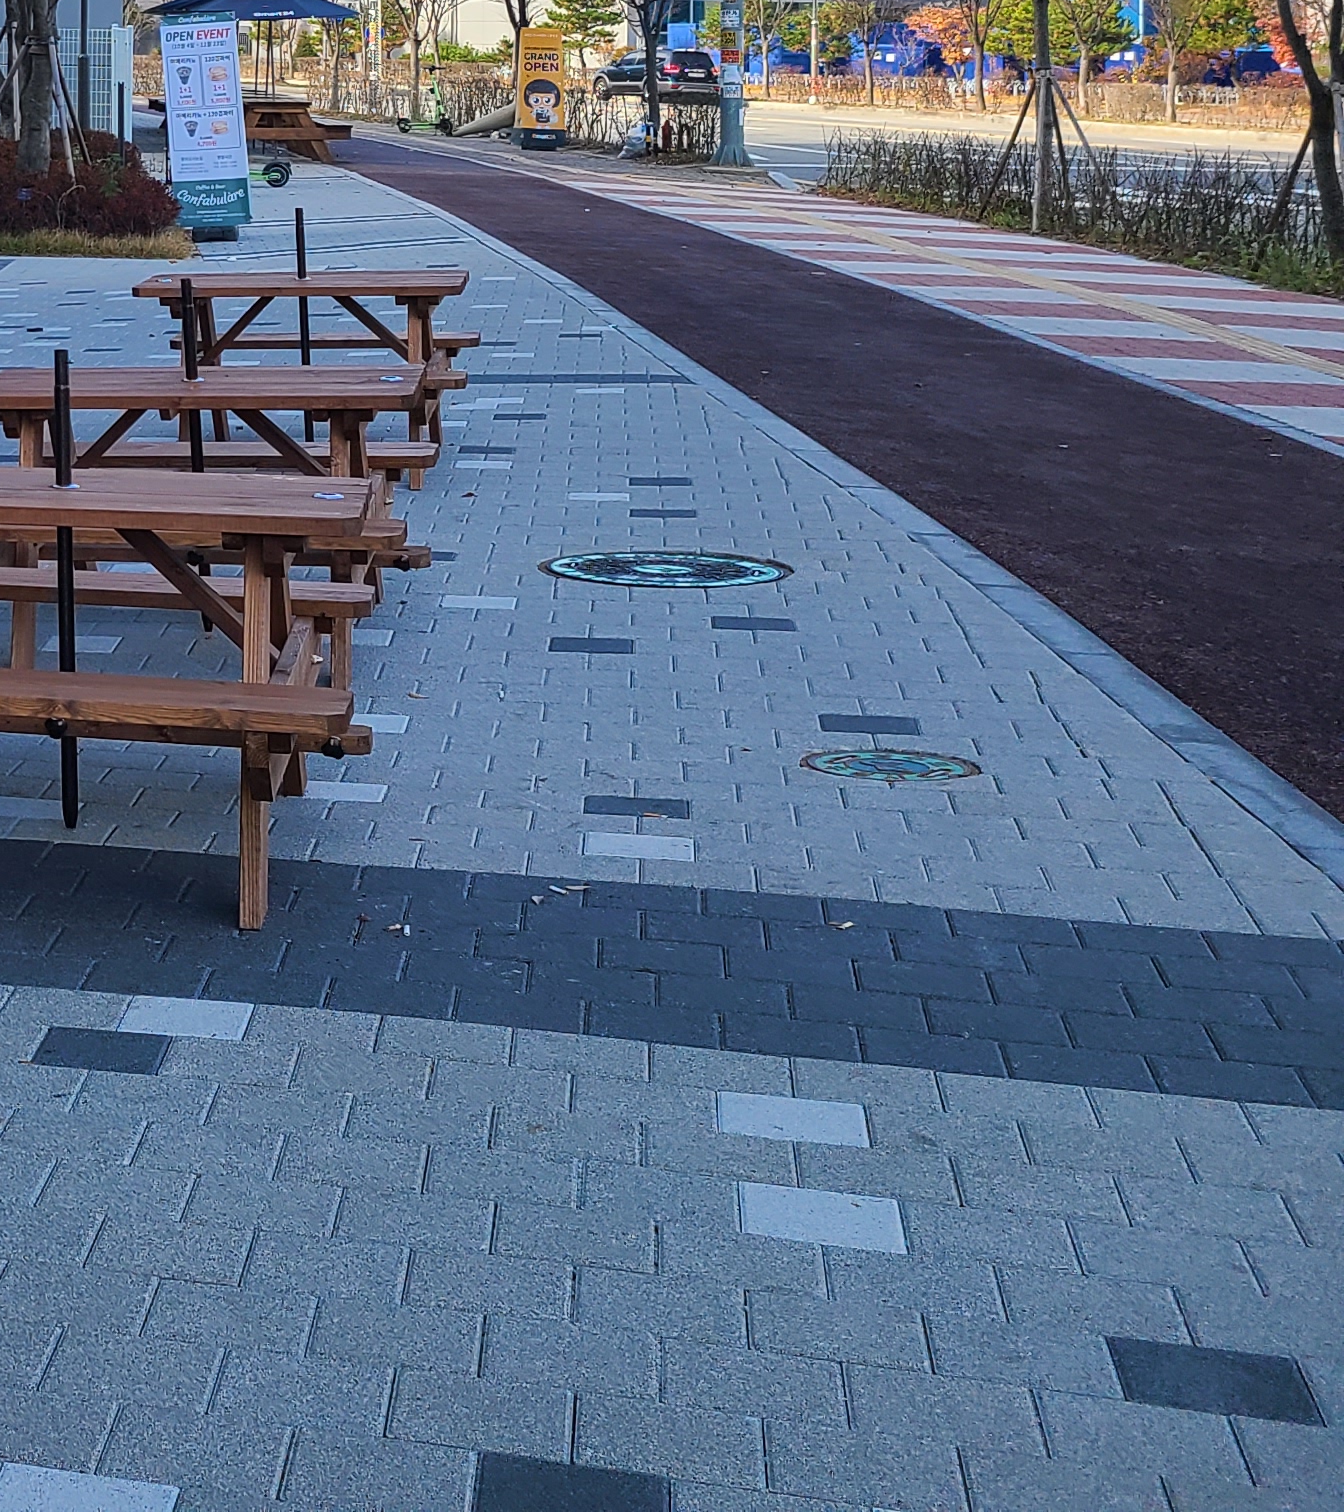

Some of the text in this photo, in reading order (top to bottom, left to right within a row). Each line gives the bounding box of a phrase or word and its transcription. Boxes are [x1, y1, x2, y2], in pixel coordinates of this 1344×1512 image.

[166, 28, 231, 42] OPEN EVENT
[524, 53, 559, 61] GRAND
[524, 62, 559, 72] OPEN
